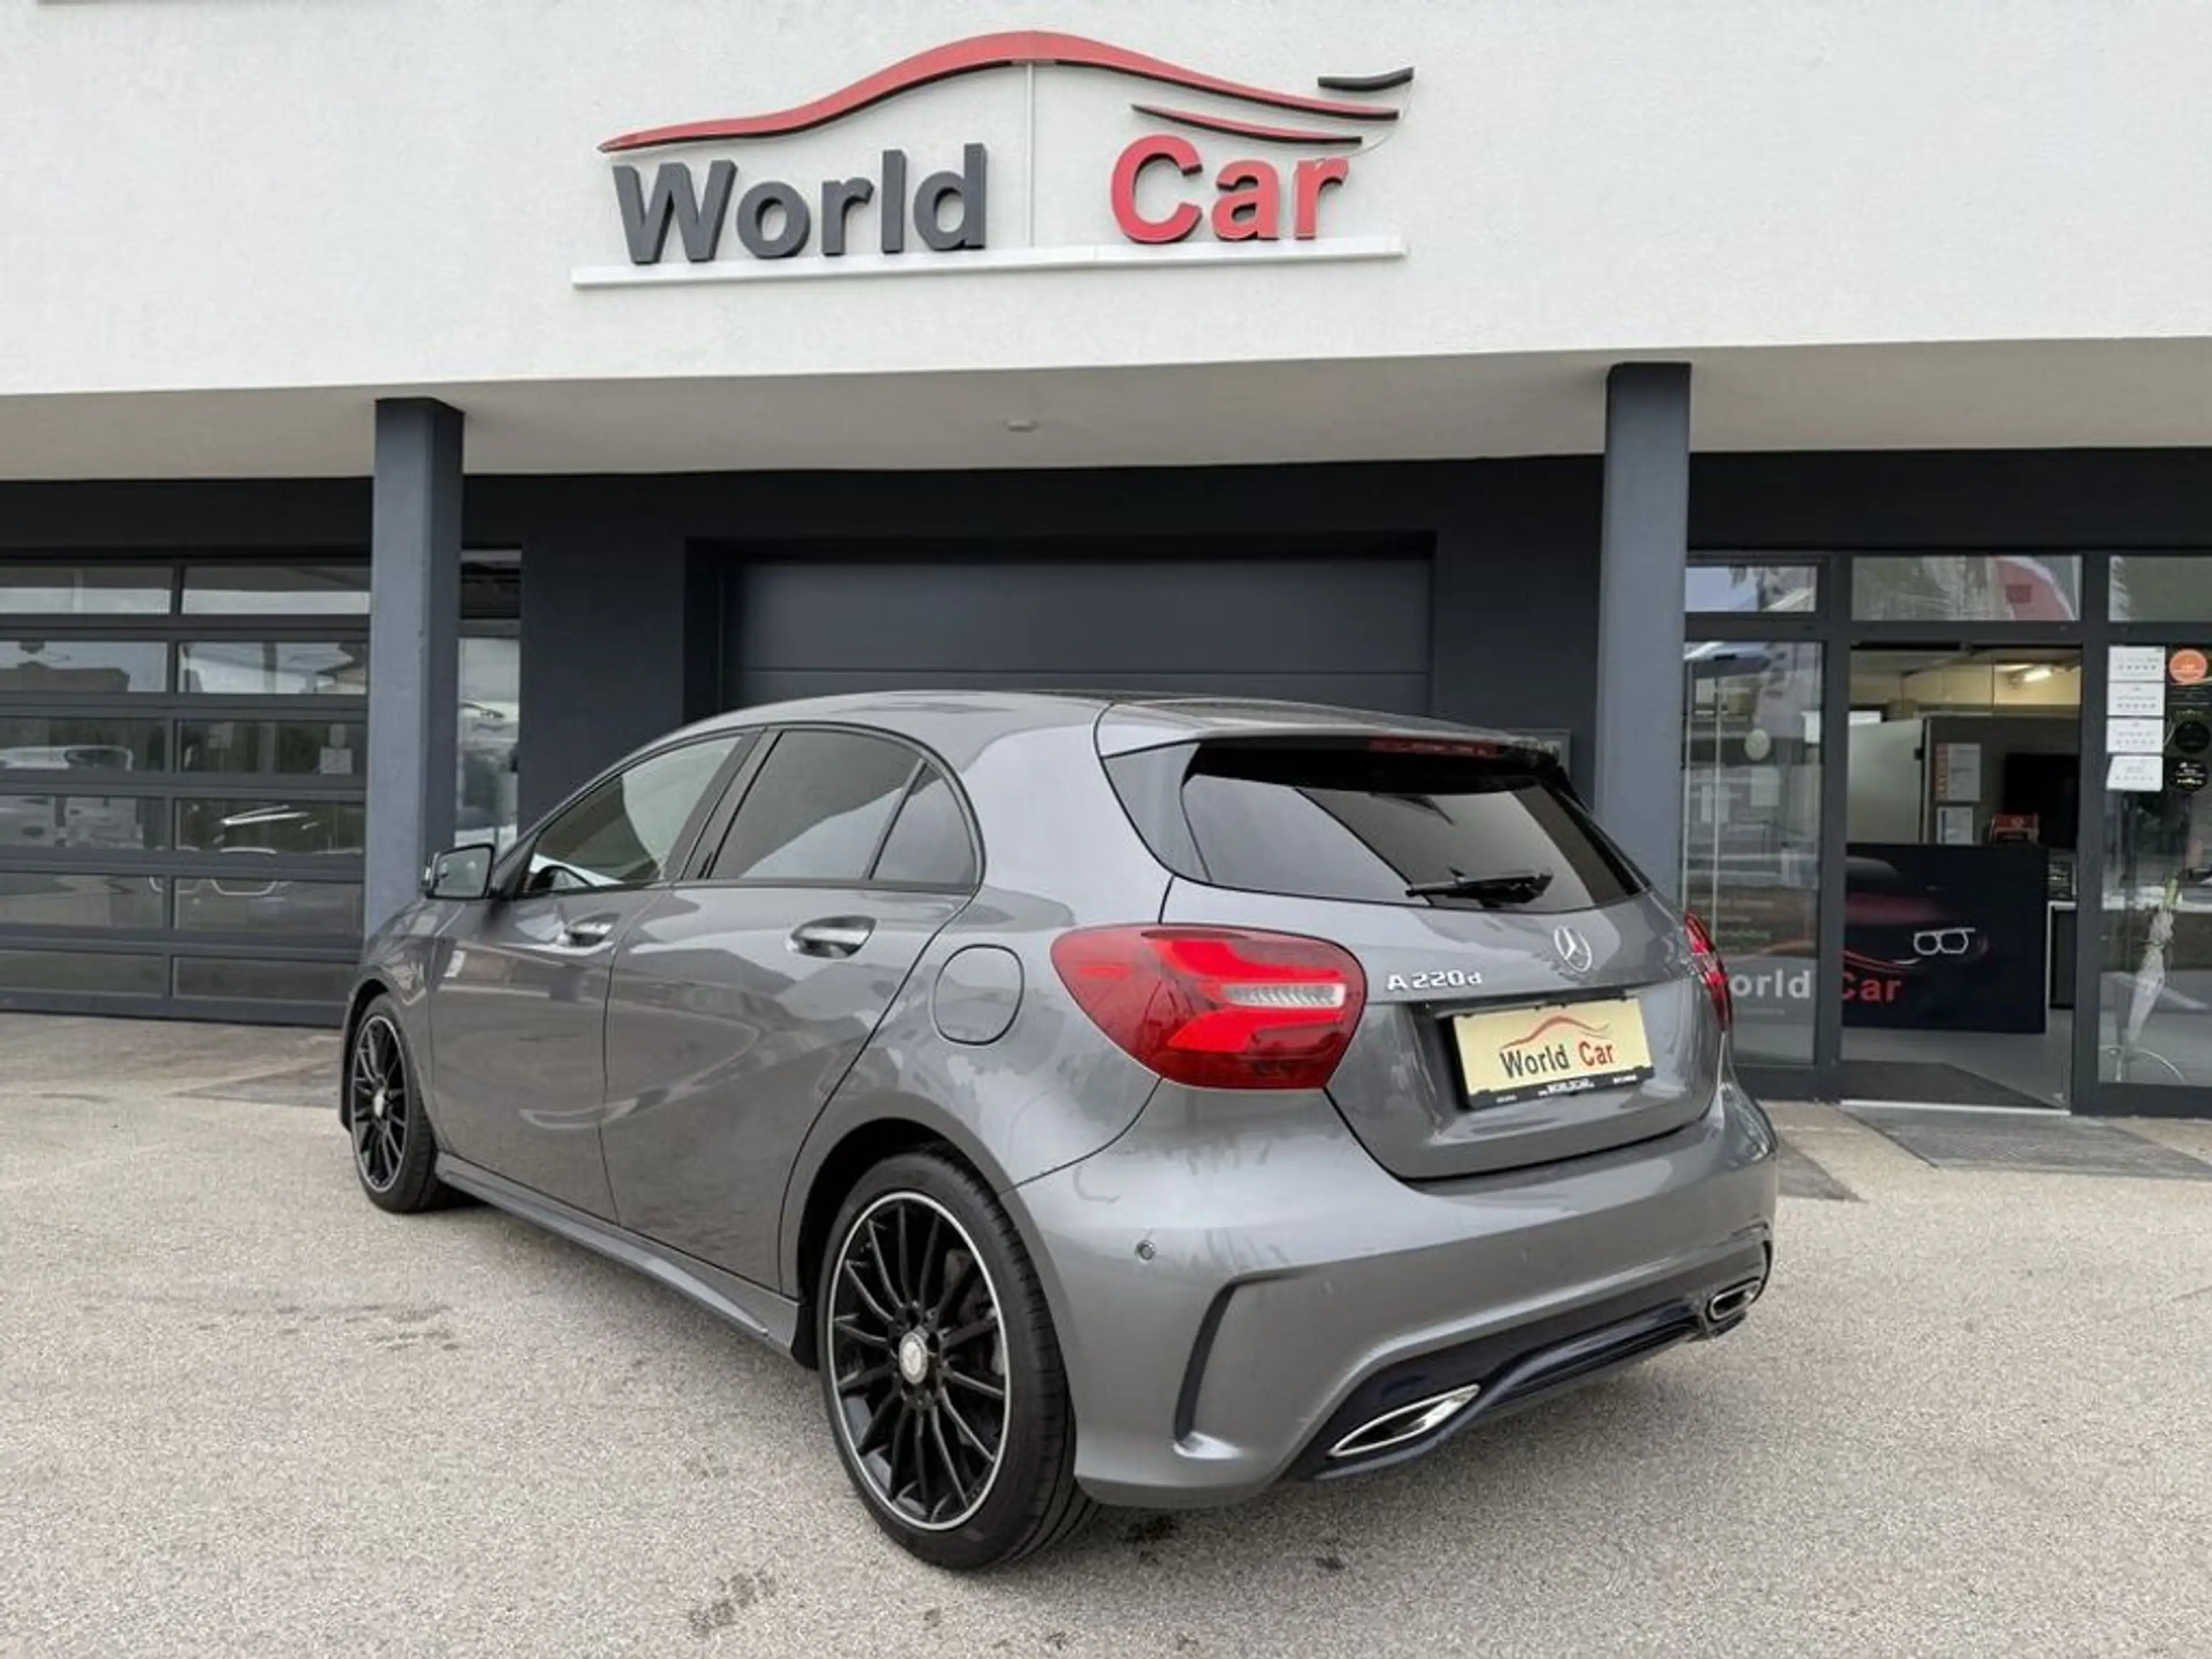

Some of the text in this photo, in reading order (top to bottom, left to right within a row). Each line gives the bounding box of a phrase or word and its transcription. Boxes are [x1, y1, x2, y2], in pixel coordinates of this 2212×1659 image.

[612, 133, 1349, 265] World Car
[1729, 968, 1810, 999] orld
[1499, 1040, 1613, 1078] World Car
